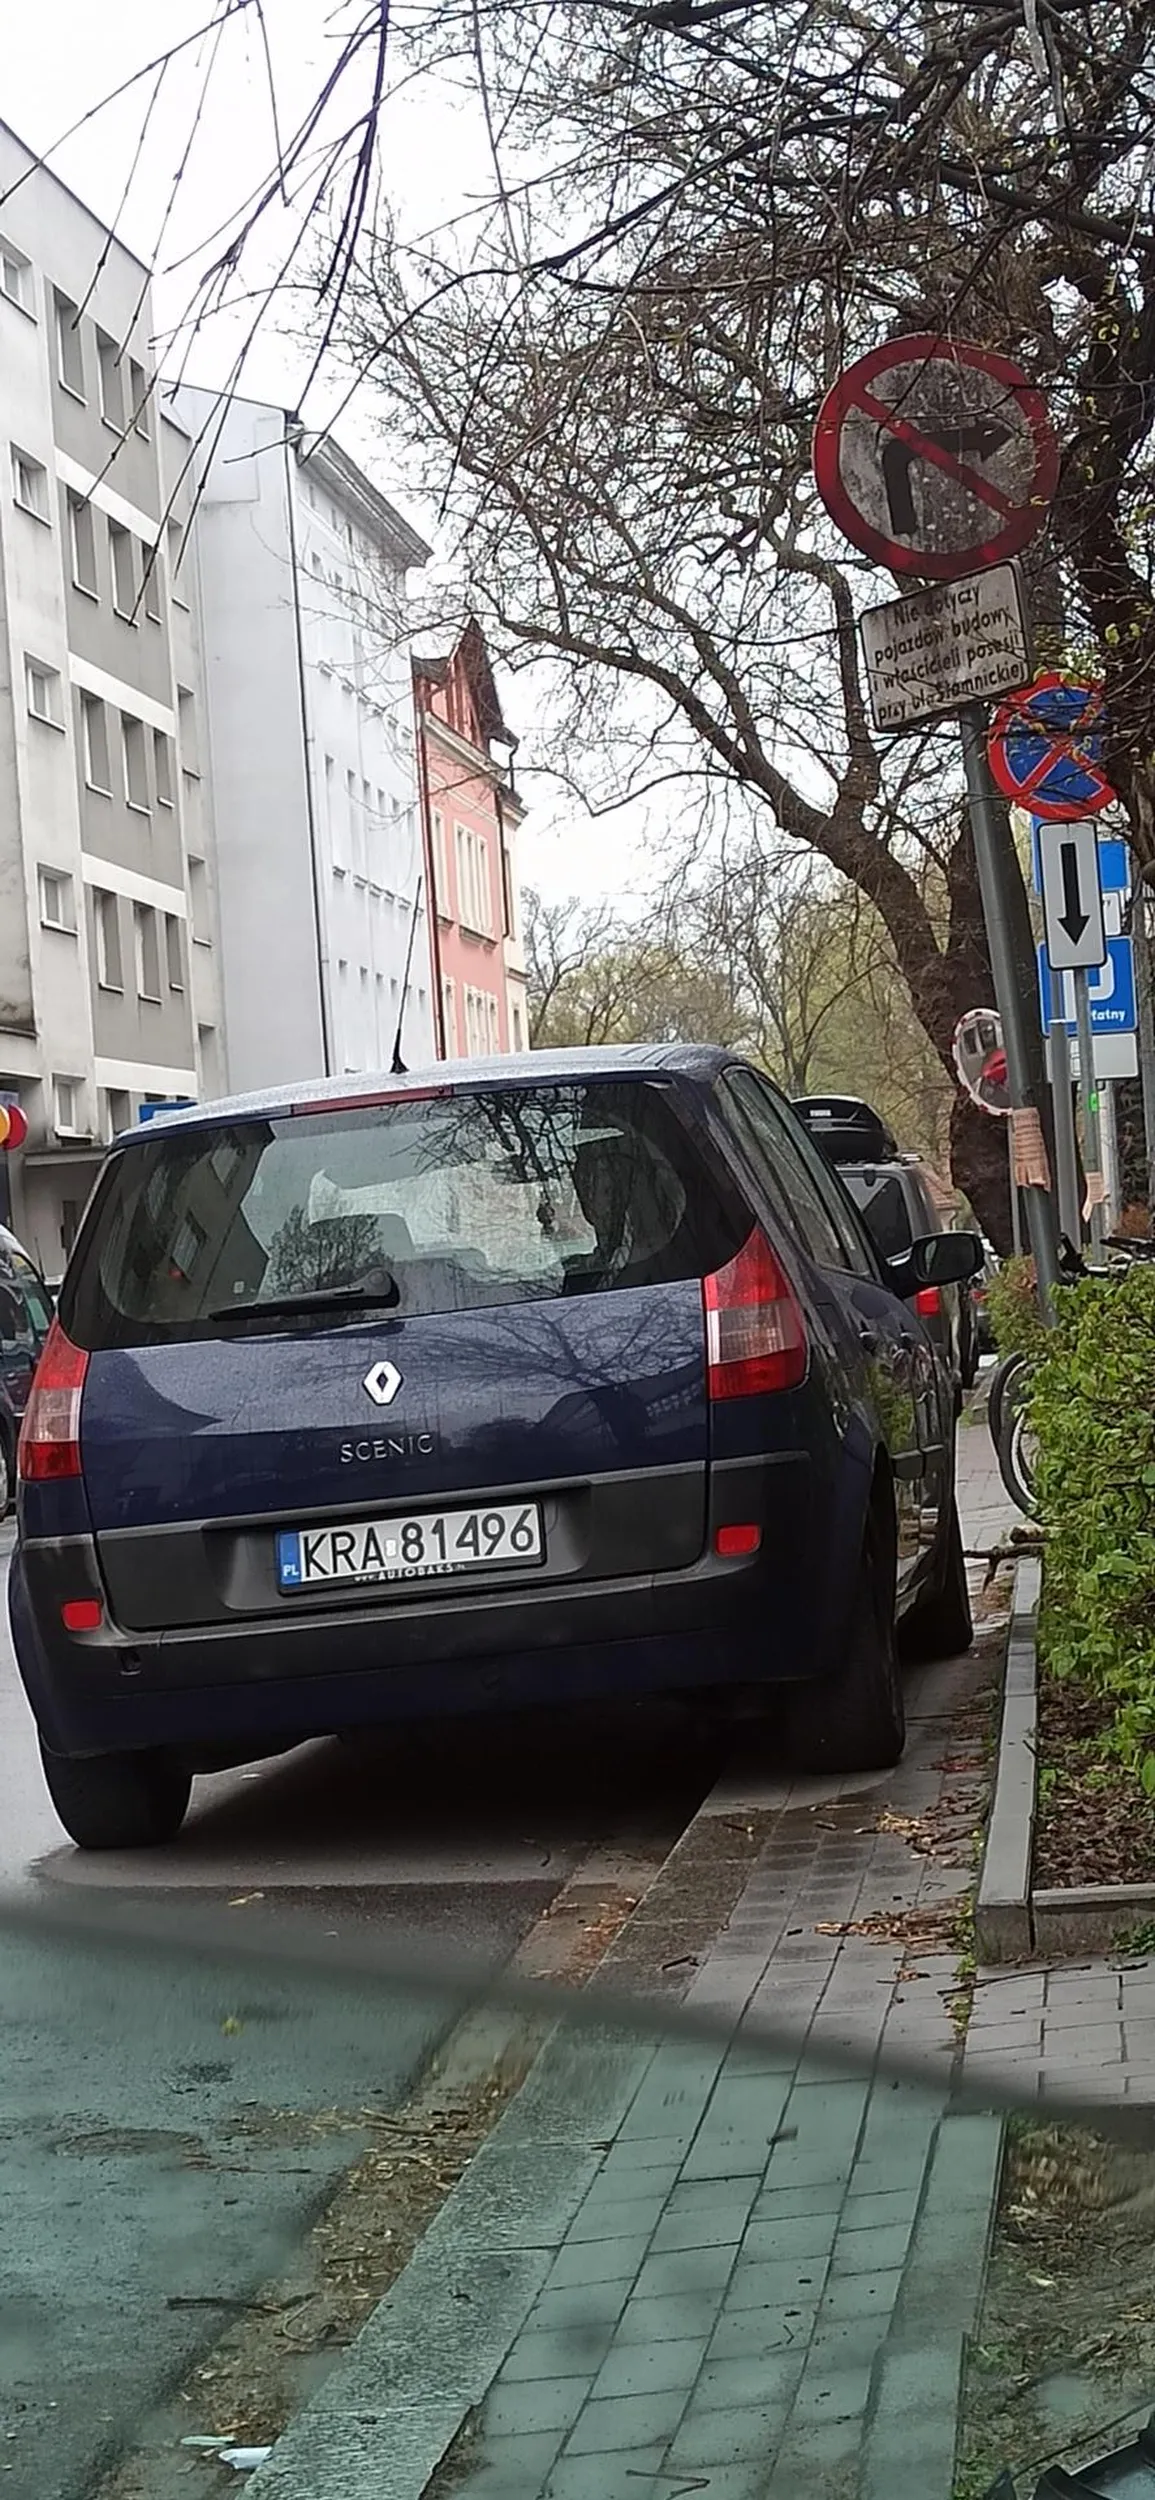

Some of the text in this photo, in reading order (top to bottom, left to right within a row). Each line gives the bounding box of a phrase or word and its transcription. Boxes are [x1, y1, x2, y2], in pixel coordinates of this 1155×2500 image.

[893, 585, 980, 626] Nie dotyczy
[874, 605, 1010, 668] pojazdów budowy
[873, 630, 1020, 692] i właścicieli posesji
[877, 701, 906, 725] przy
[340, 1434, 433, 1463] SCENIC
[303, 1509, 535, 1578] KRA 81496
[283, 1564, 299, 1577] PL
